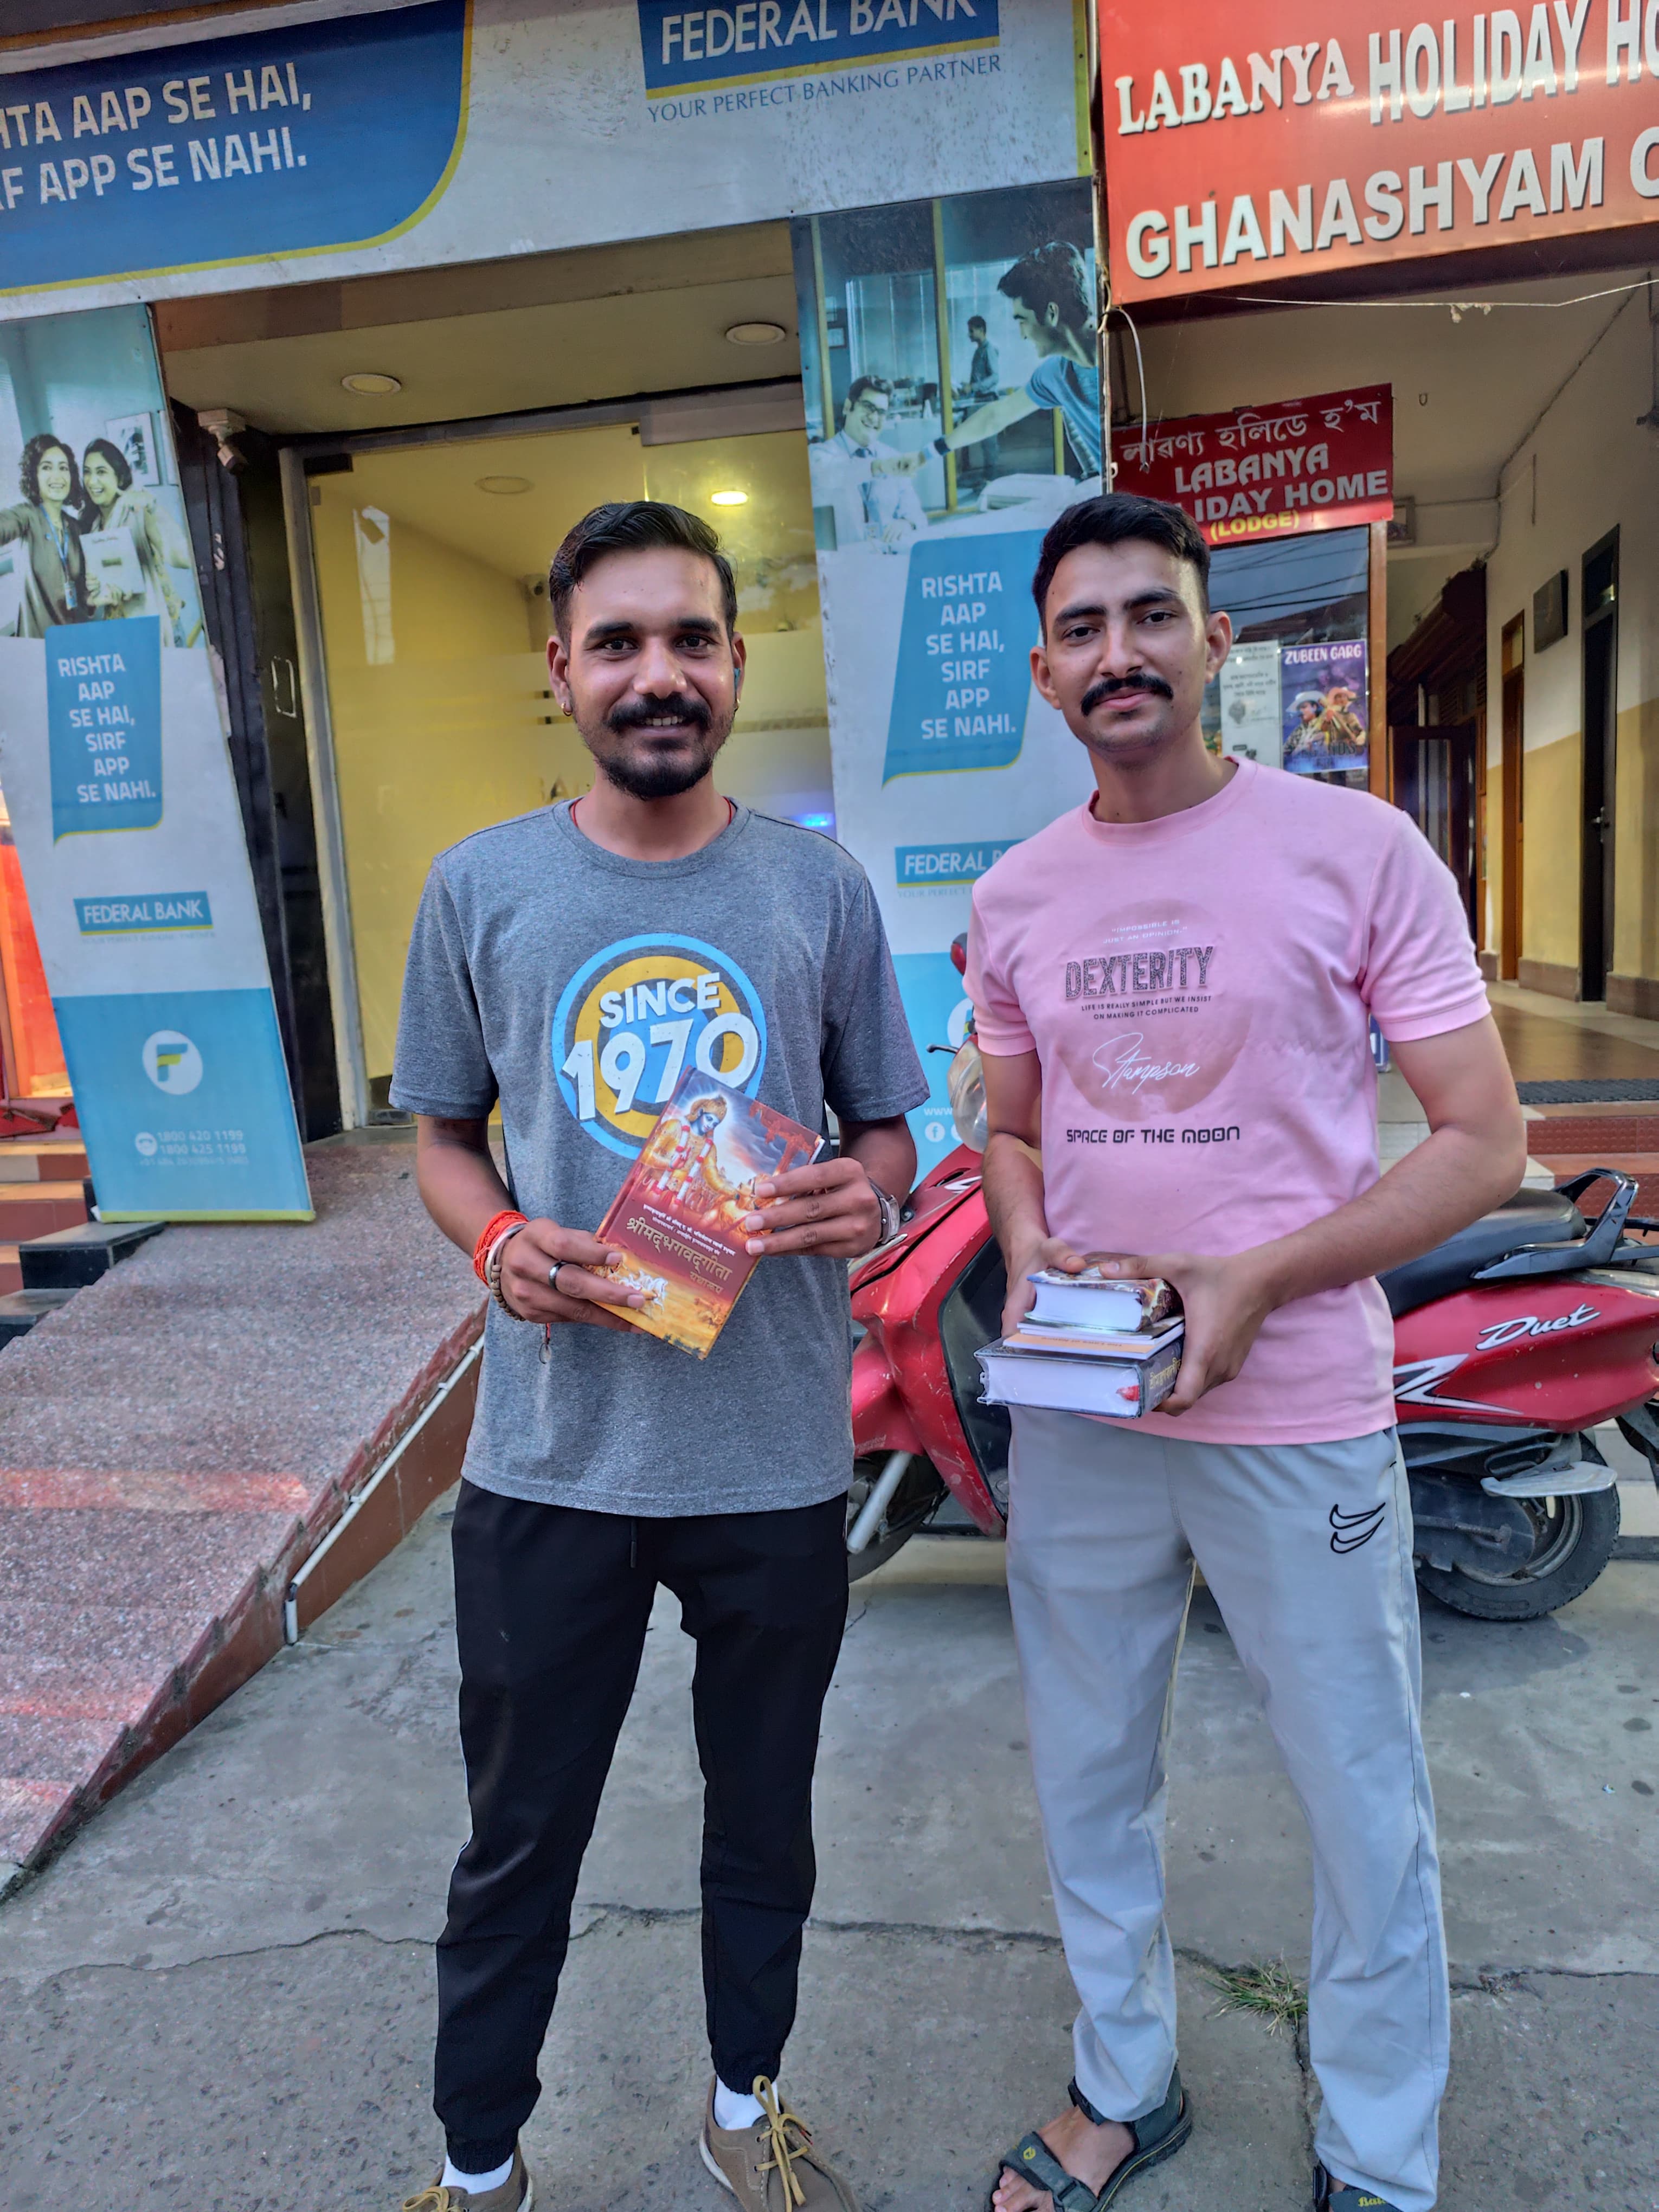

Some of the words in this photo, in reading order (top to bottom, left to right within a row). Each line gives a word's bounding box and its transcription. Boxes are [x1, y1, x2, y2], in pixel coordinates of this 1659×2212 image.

[661, 0, 838, 65] FEDERAL
[1115, 38, 1355, 136] LABANYA
[1368, 0, 1589, 125] HOLIDAY
[73, 87, 152, 138] AAP
[164, 76, 216, 124] SE
[224, 62, 311, 114] HAI,
[647, 99, 706, 123] YOUR
[713, 85, 795, 114] PERFECT
[803, 69, 899, 101] BANKING
[907, 54, 1001, 85] PARTNER
[40, 155, 116, 205] APP
[126, 144, 179, 191] SE
[188, 127, 307, 182] NAHI.
[1125, 137, 1605, 279] GHANASHYAM
[1216, 411, 1309, 452] হলিডে
[1174, 443, 1329, 494] LABANYA
[1178, 488, 1274, 522] IDAY
[1285, 470, 1389, 509] HOME
[1210, 510, 1300, 542] (LODGE)
[922, 571, 1003, 599] RISHTA
[941, 602, 986, 626] AAP
[925, 633, 953, 656] SE
[960, 629, 1005, 653] HAI,
[1284, 648, 1328, 665] ZUBEEN
[1330, 644, 1362, 660] GARG
[57, 653, 126, 677] RISHTA
[941, 659, 991, 683] SIRF
[78, 681, 115, 702] AAP
[946, 687, 990, 710] APP
[69, 709, 93, 728] SE
[97, 705, 136, 726] HAI,
[921, 717, 948, 740] SE
[954, 713, 1016, 737] NAHI.
[85, 731, 126, 752] SIRF
[94, 757, 130, 776] APP
[76, 784, 101, 803] SE
[105, 781, 157, 801] NAHI.
[904, 850, 987, 876] FEDERAL
[83, 902, 153, 924] FEDERAL
[155, 899, 204, 920] BANK
[1065, 946, 1214, 998] DEXTERITY
[600, 972, 721, 1028] SINCE
[1131, 999, 1159, 1008] SIMPLE
[1145, 1006, 1199, 1016] COMPLICATED
[561, 1012, 759, 1121] 1970
[1066, 1129, 1108, 1143] SPACE
[1113, 1129, 1135, 1143] OF
[1141, 1129, 1174, 1143] THE
[1182, 1126, 1240, 1143] MOON
[1476, 1302, 1601, 1351] Duet
